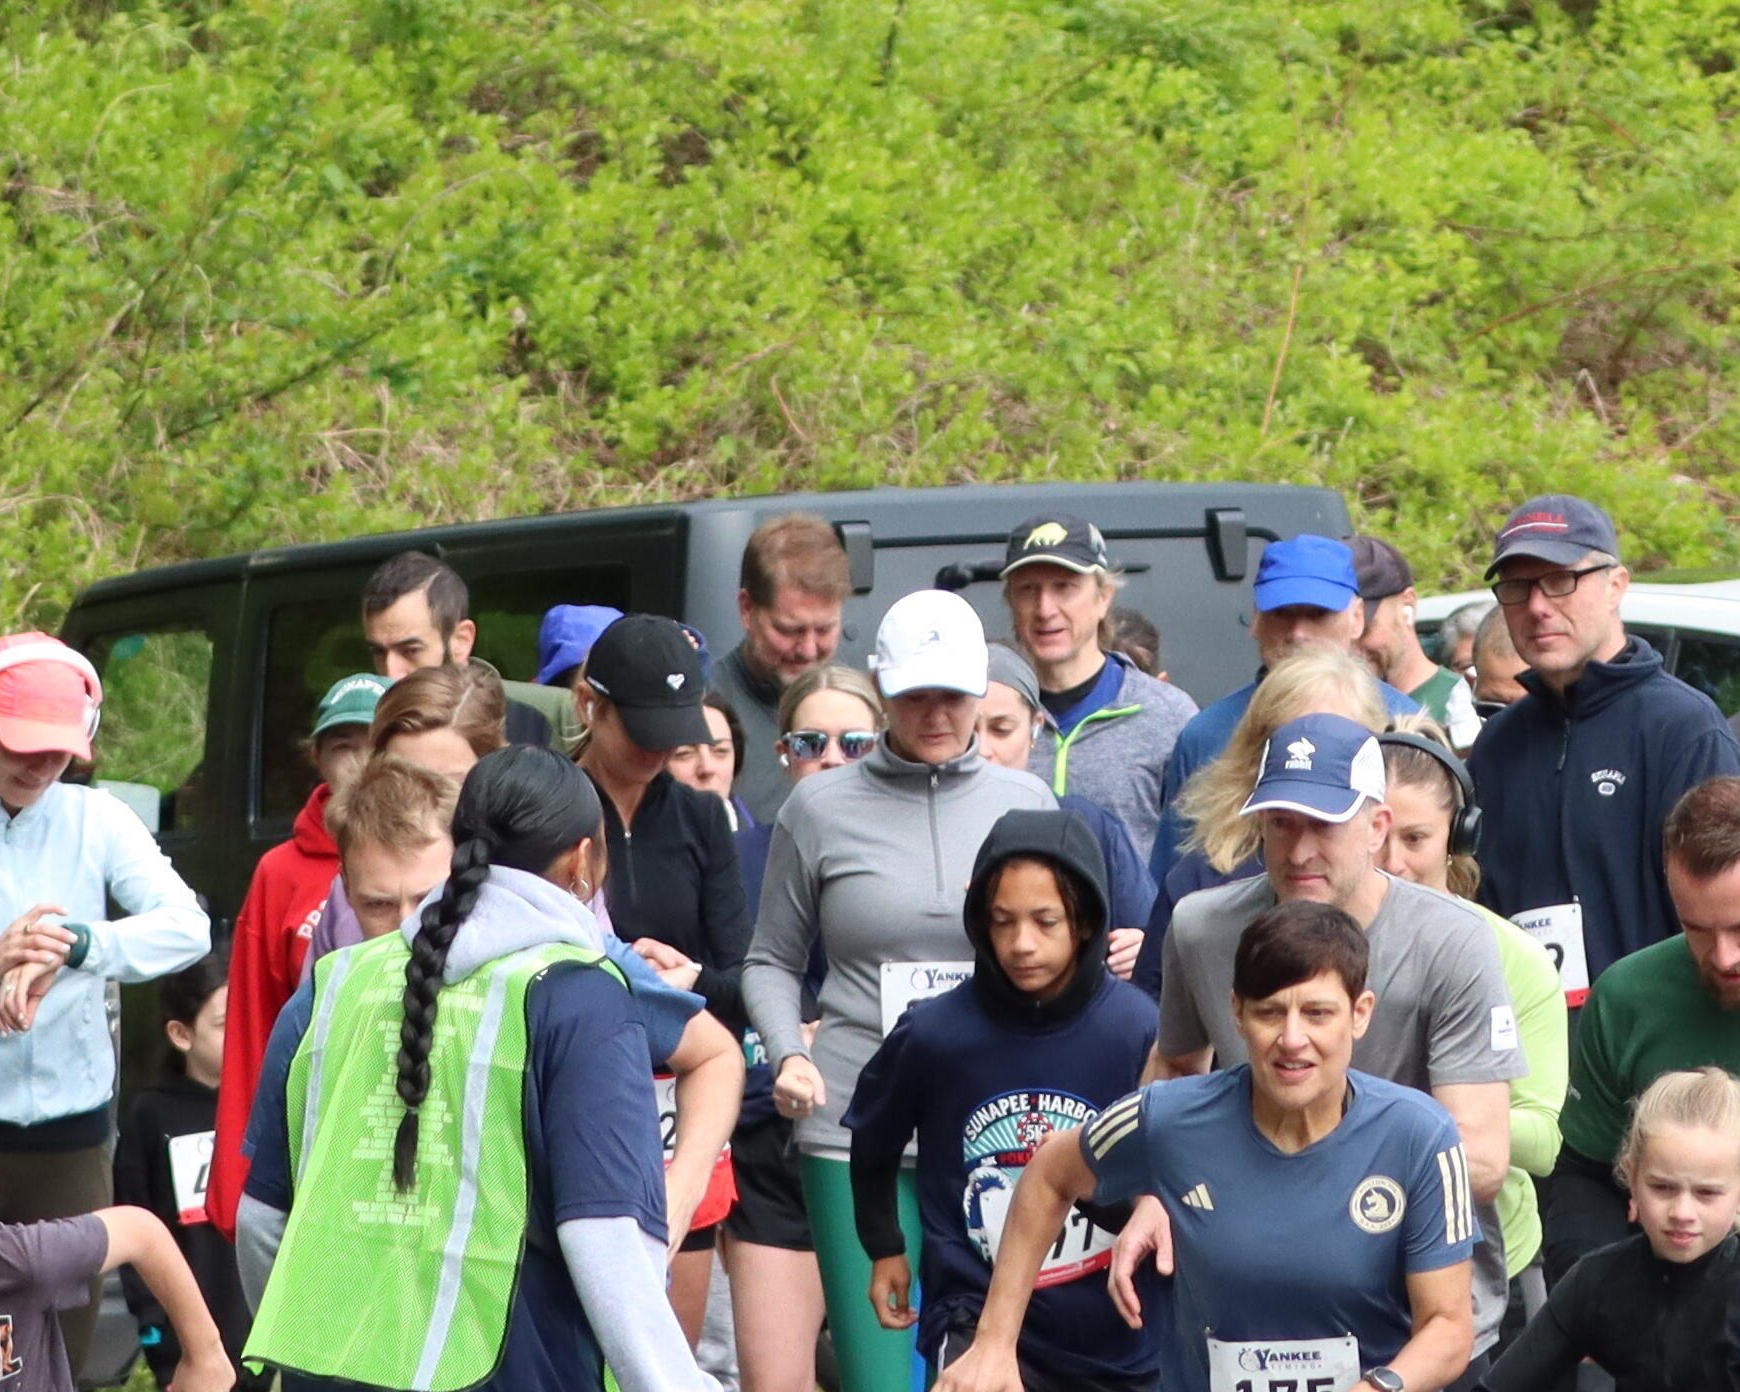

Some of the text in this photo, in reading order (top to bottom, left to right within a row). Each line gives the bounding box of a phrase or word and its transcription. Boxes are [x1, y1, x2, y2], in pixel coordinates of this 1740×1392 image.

[927, 967, 972, 988] YANKE
[965, 1094, 1100, 1142] SUNAPEE HARBO
[1254, 1349, 1323, 1371] YANKEE
